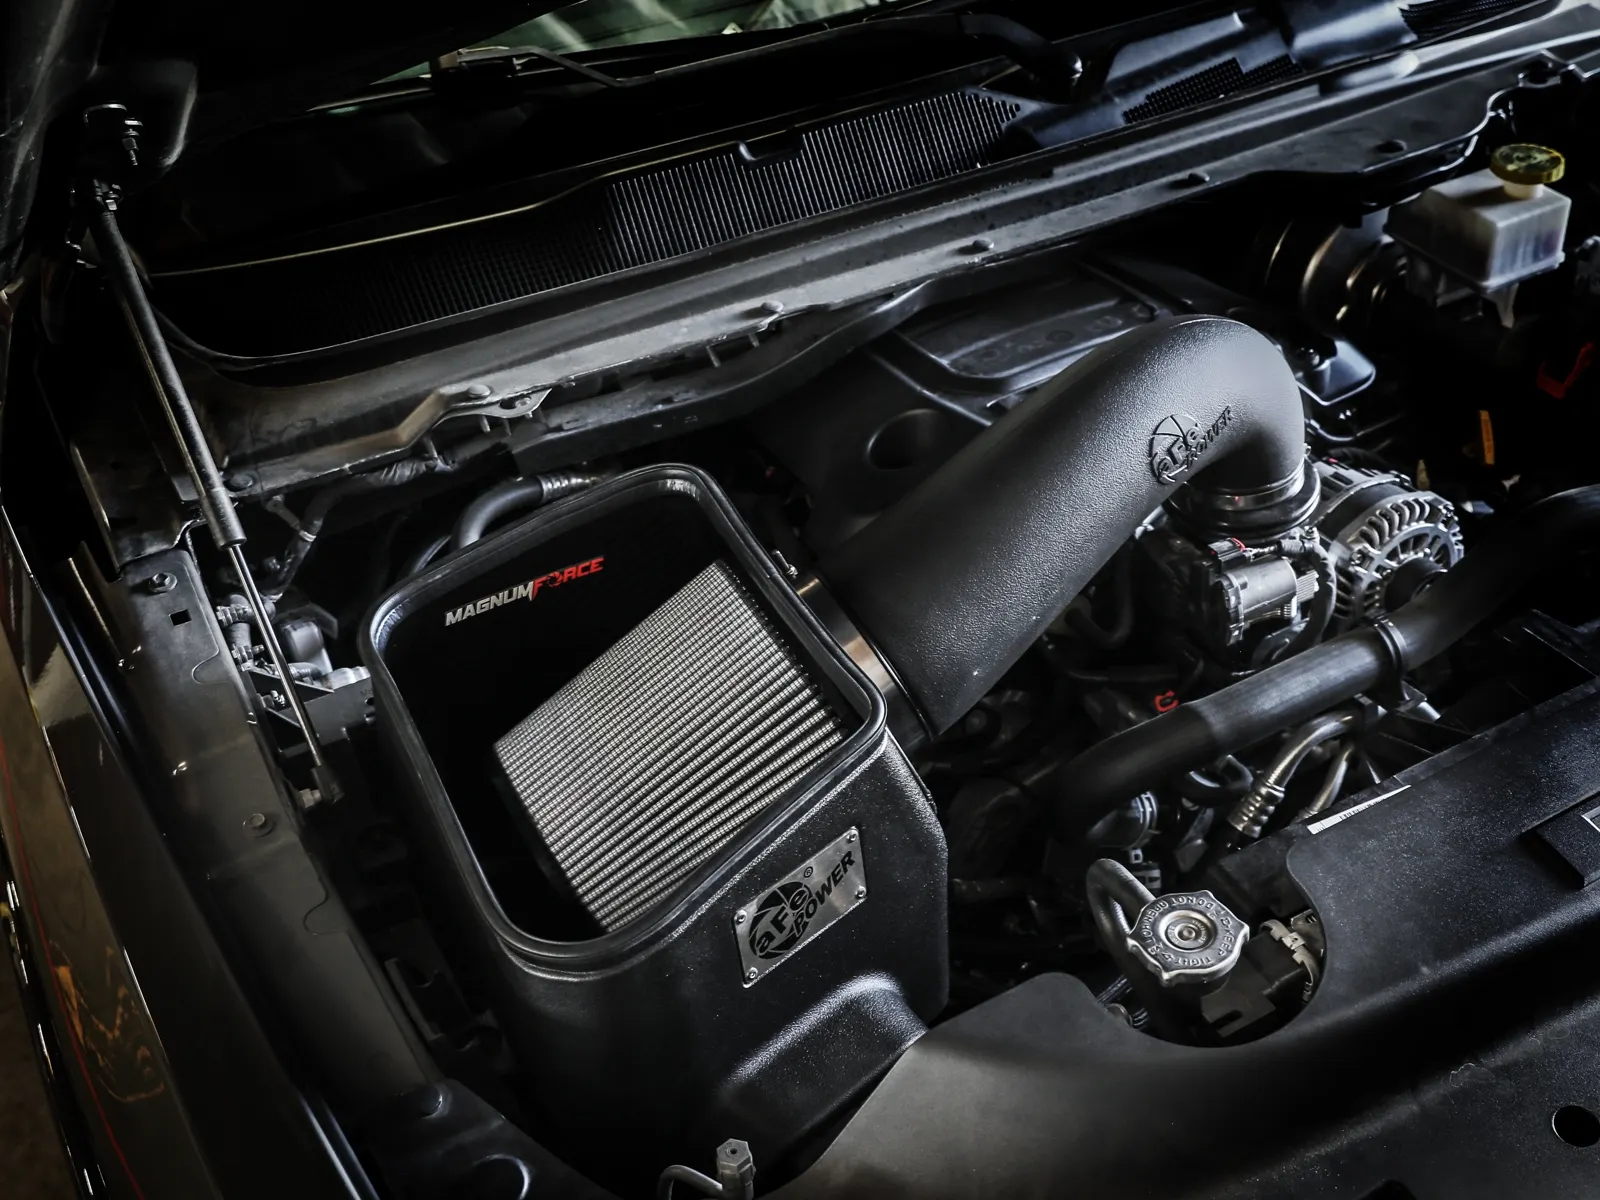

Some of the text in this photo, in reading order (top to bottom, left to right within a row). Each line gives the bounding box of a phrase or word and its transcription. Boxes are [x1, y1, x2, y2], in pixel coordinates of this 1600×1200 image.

[794, 850, 855, 937] POWER
[1171, 896, 1196, 906] NOT
[755, 889, 809, 954] aFe
[1143, 899, 1169, 923] OPEN
[1218, 928, 1235, 956] KEEP
[1175, 956, 1212, 966] TIGHT
